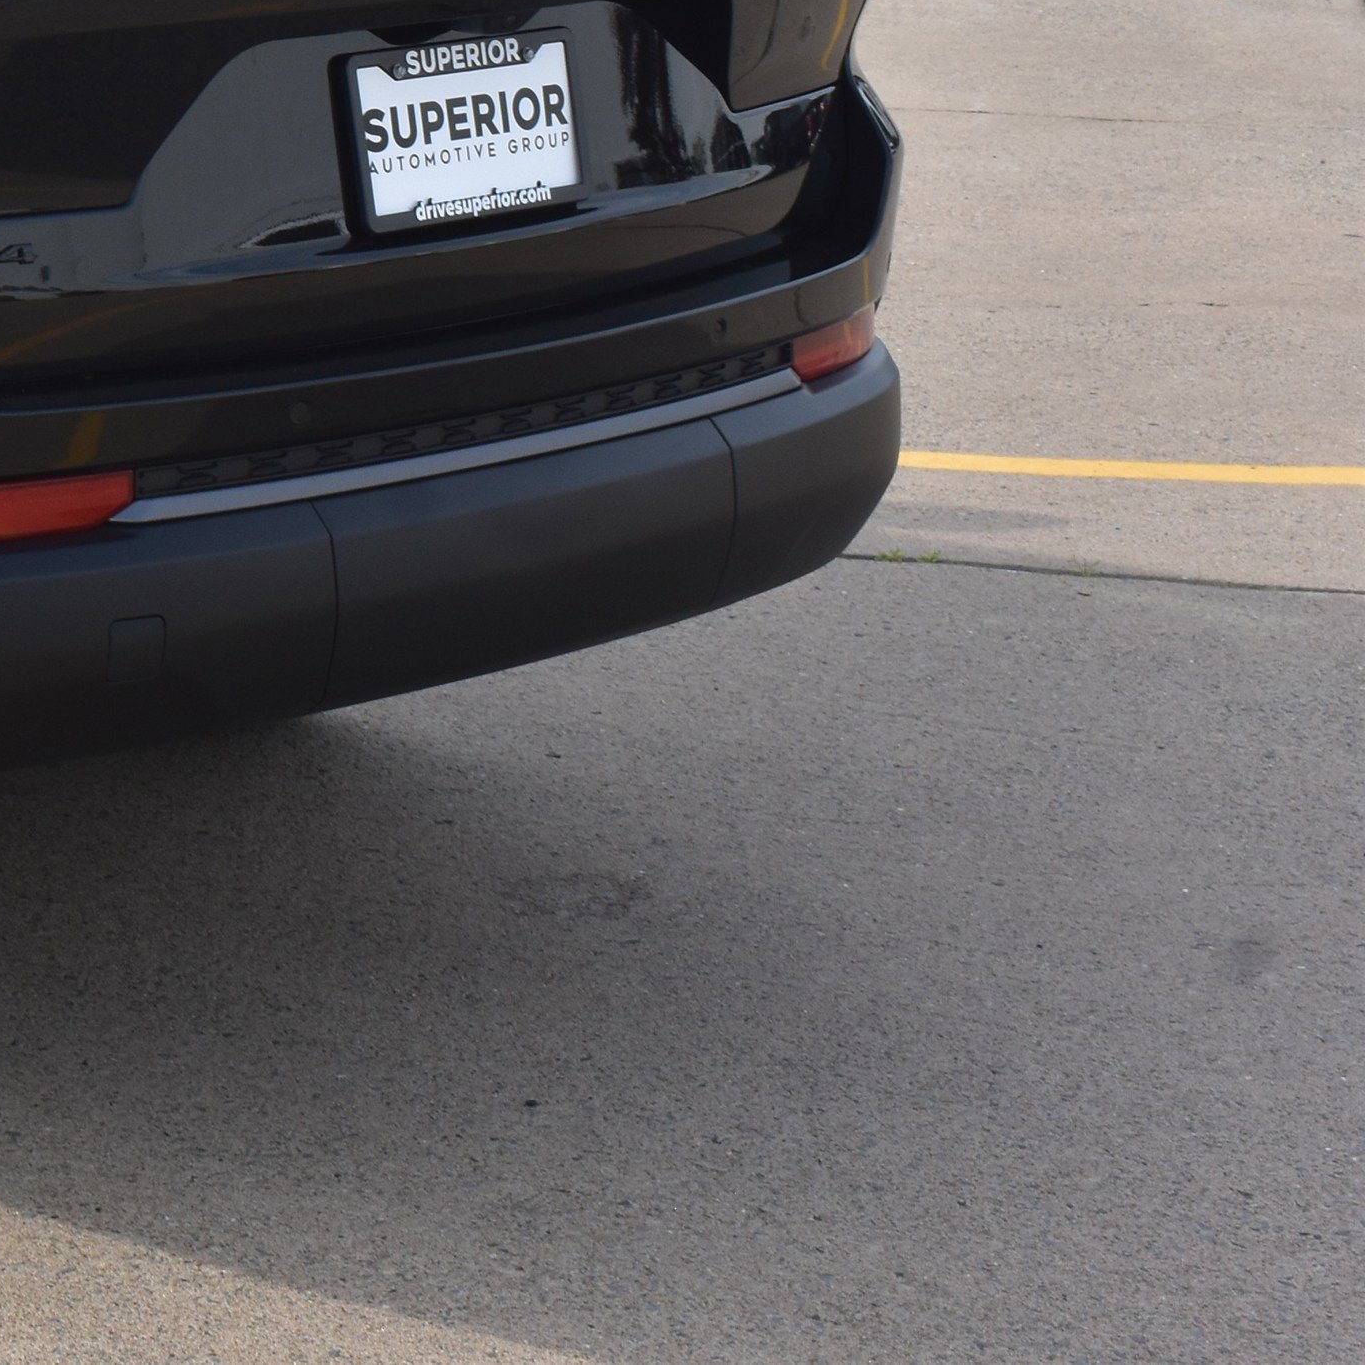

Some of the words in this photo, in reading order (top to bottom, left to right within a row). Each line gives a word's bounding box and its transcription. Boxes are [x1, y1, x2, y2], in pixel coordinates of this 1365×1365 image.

[405, 37, 521, 76] SUPERIOR
[362, 83, 568, 153] SUPERIOR
[369, 141, 496, 175] AUTOMOTIVE
[507, 131, 570, 154] GROUP
[415, 184, 552, 222] drivesuperior.com
